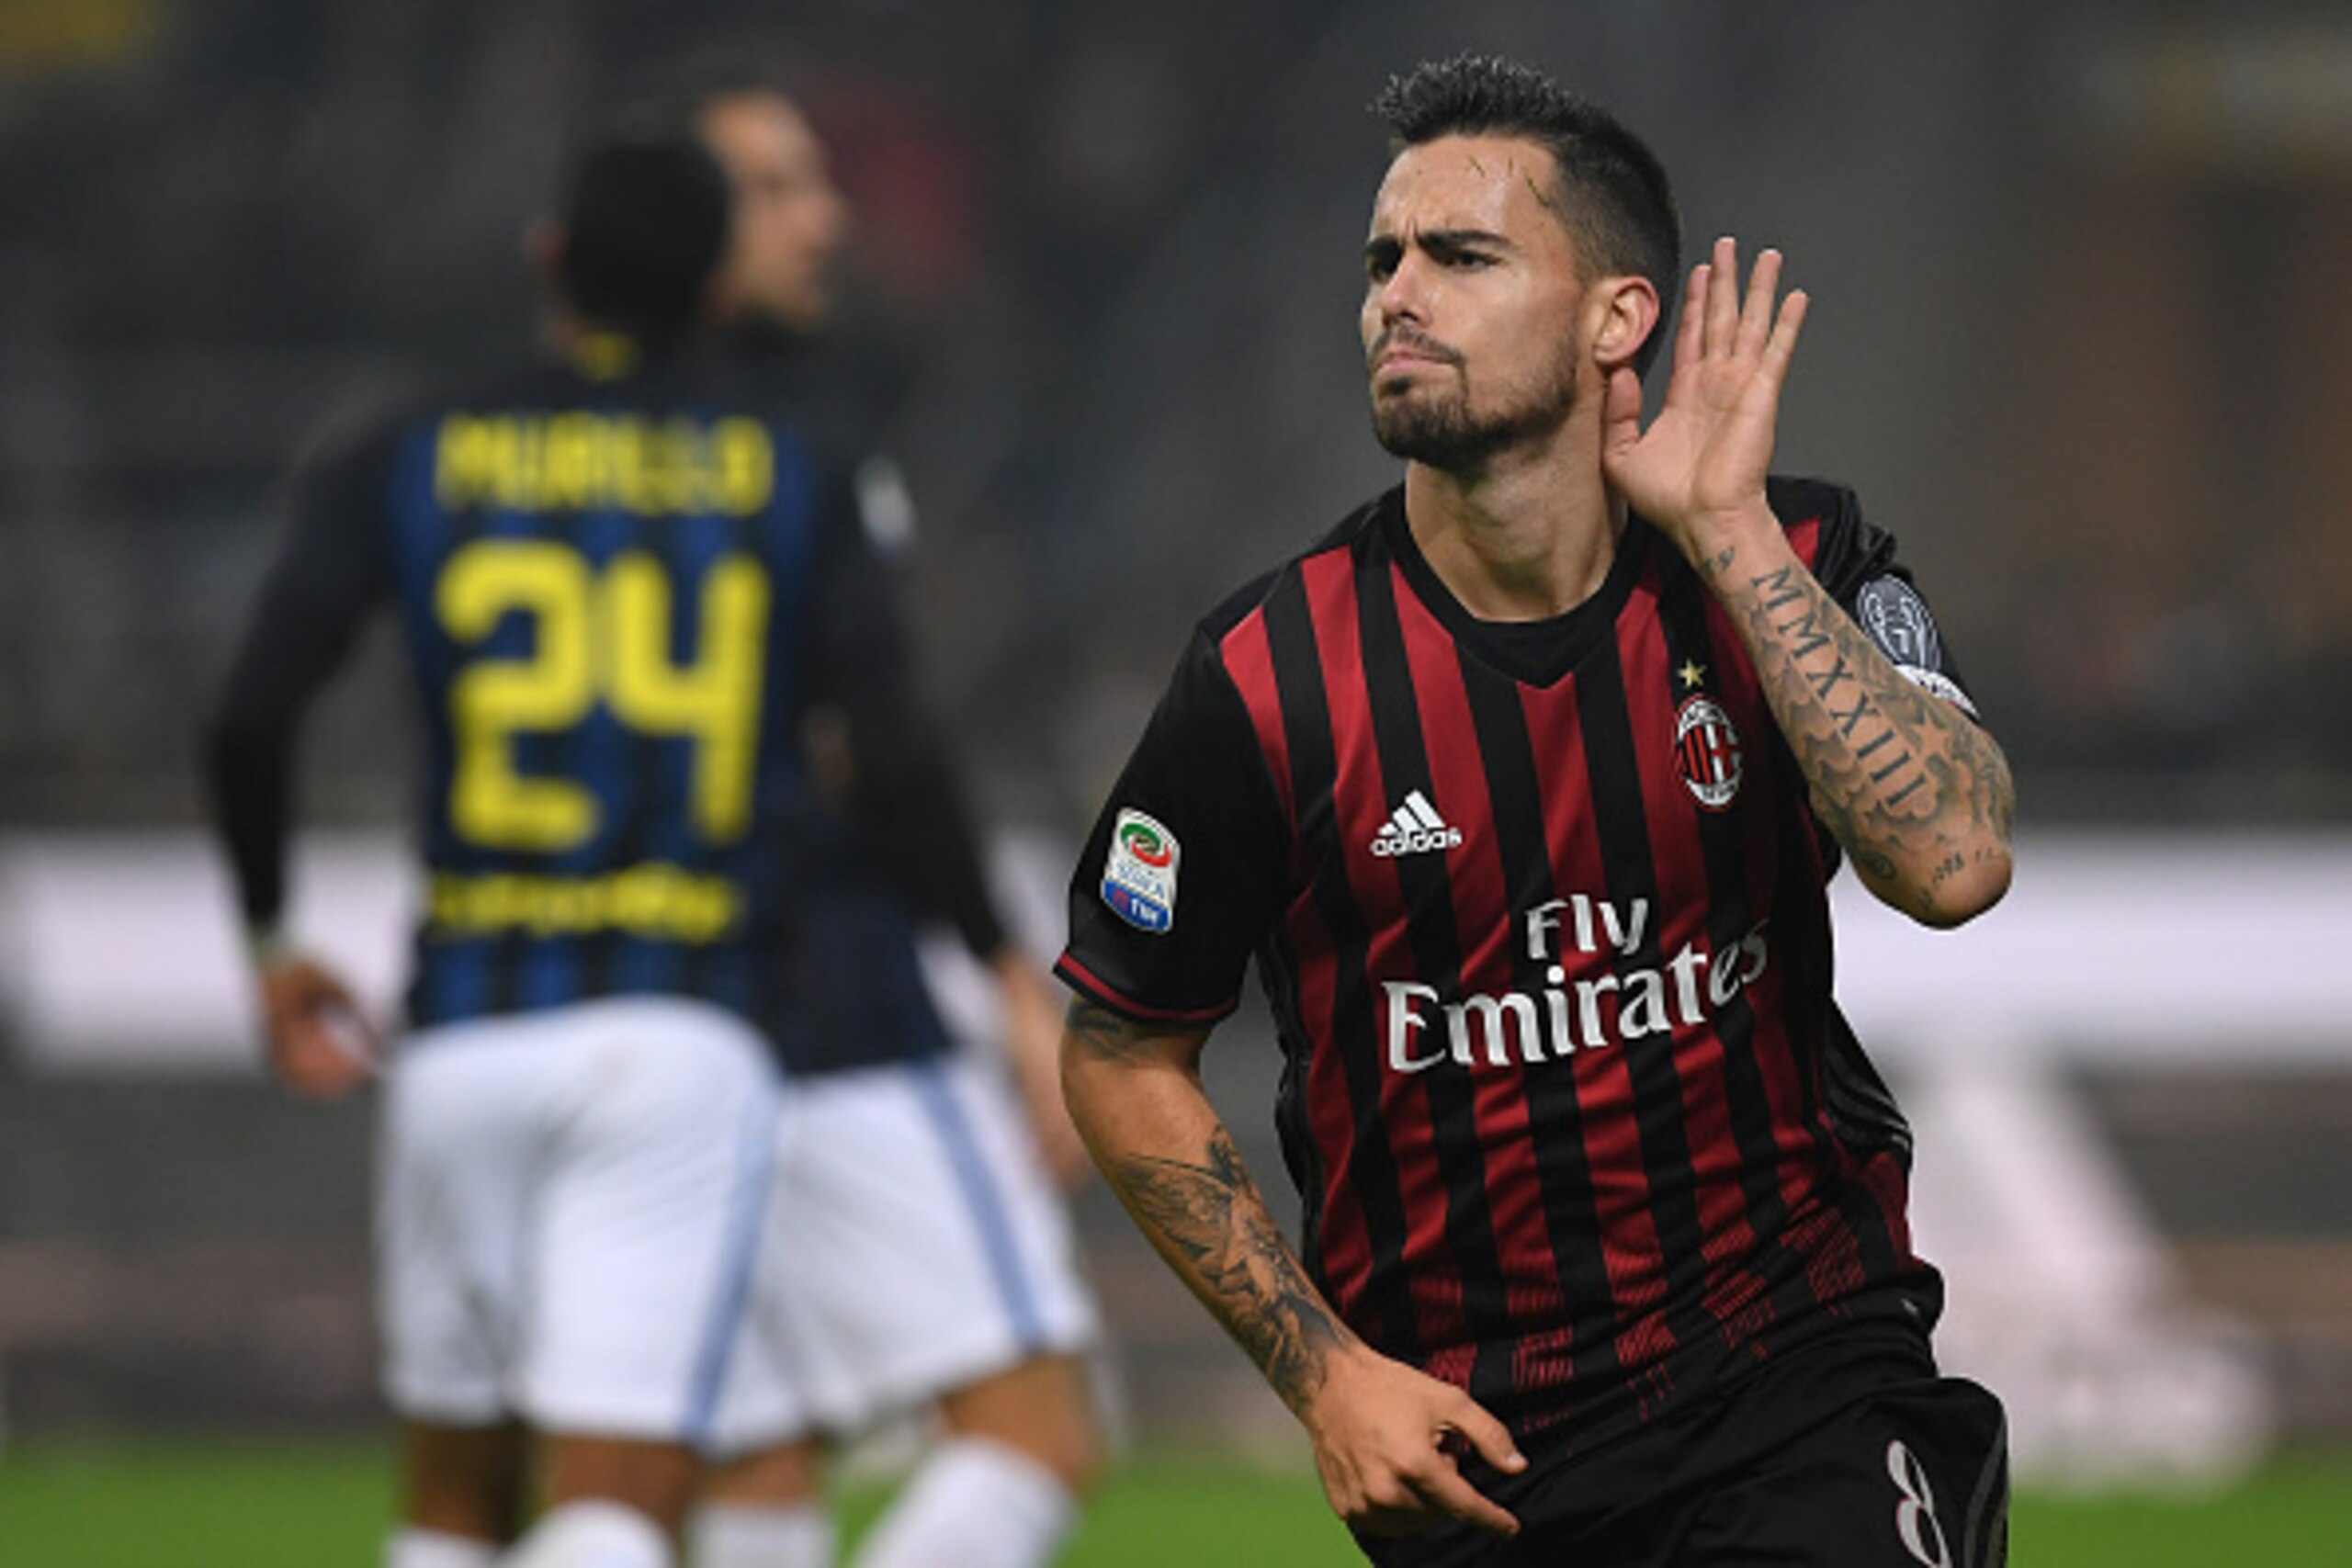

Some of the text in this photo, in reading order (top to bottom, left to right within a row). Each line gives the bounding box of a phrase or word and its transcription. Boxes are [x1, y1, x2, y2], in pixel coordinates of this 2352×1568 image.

[436, 537, 770, 852] 24
[1752, 565, 1928, 807] MMXXIII
[1893, 628, 1909, 654] 7
[1369, 826, 1462, 856] adidas
[1525, 894, 1648, 959] Fly
[1382, 919, 1769, 1073] Emirates
[1886, 1439, 1953, 1568] 8
